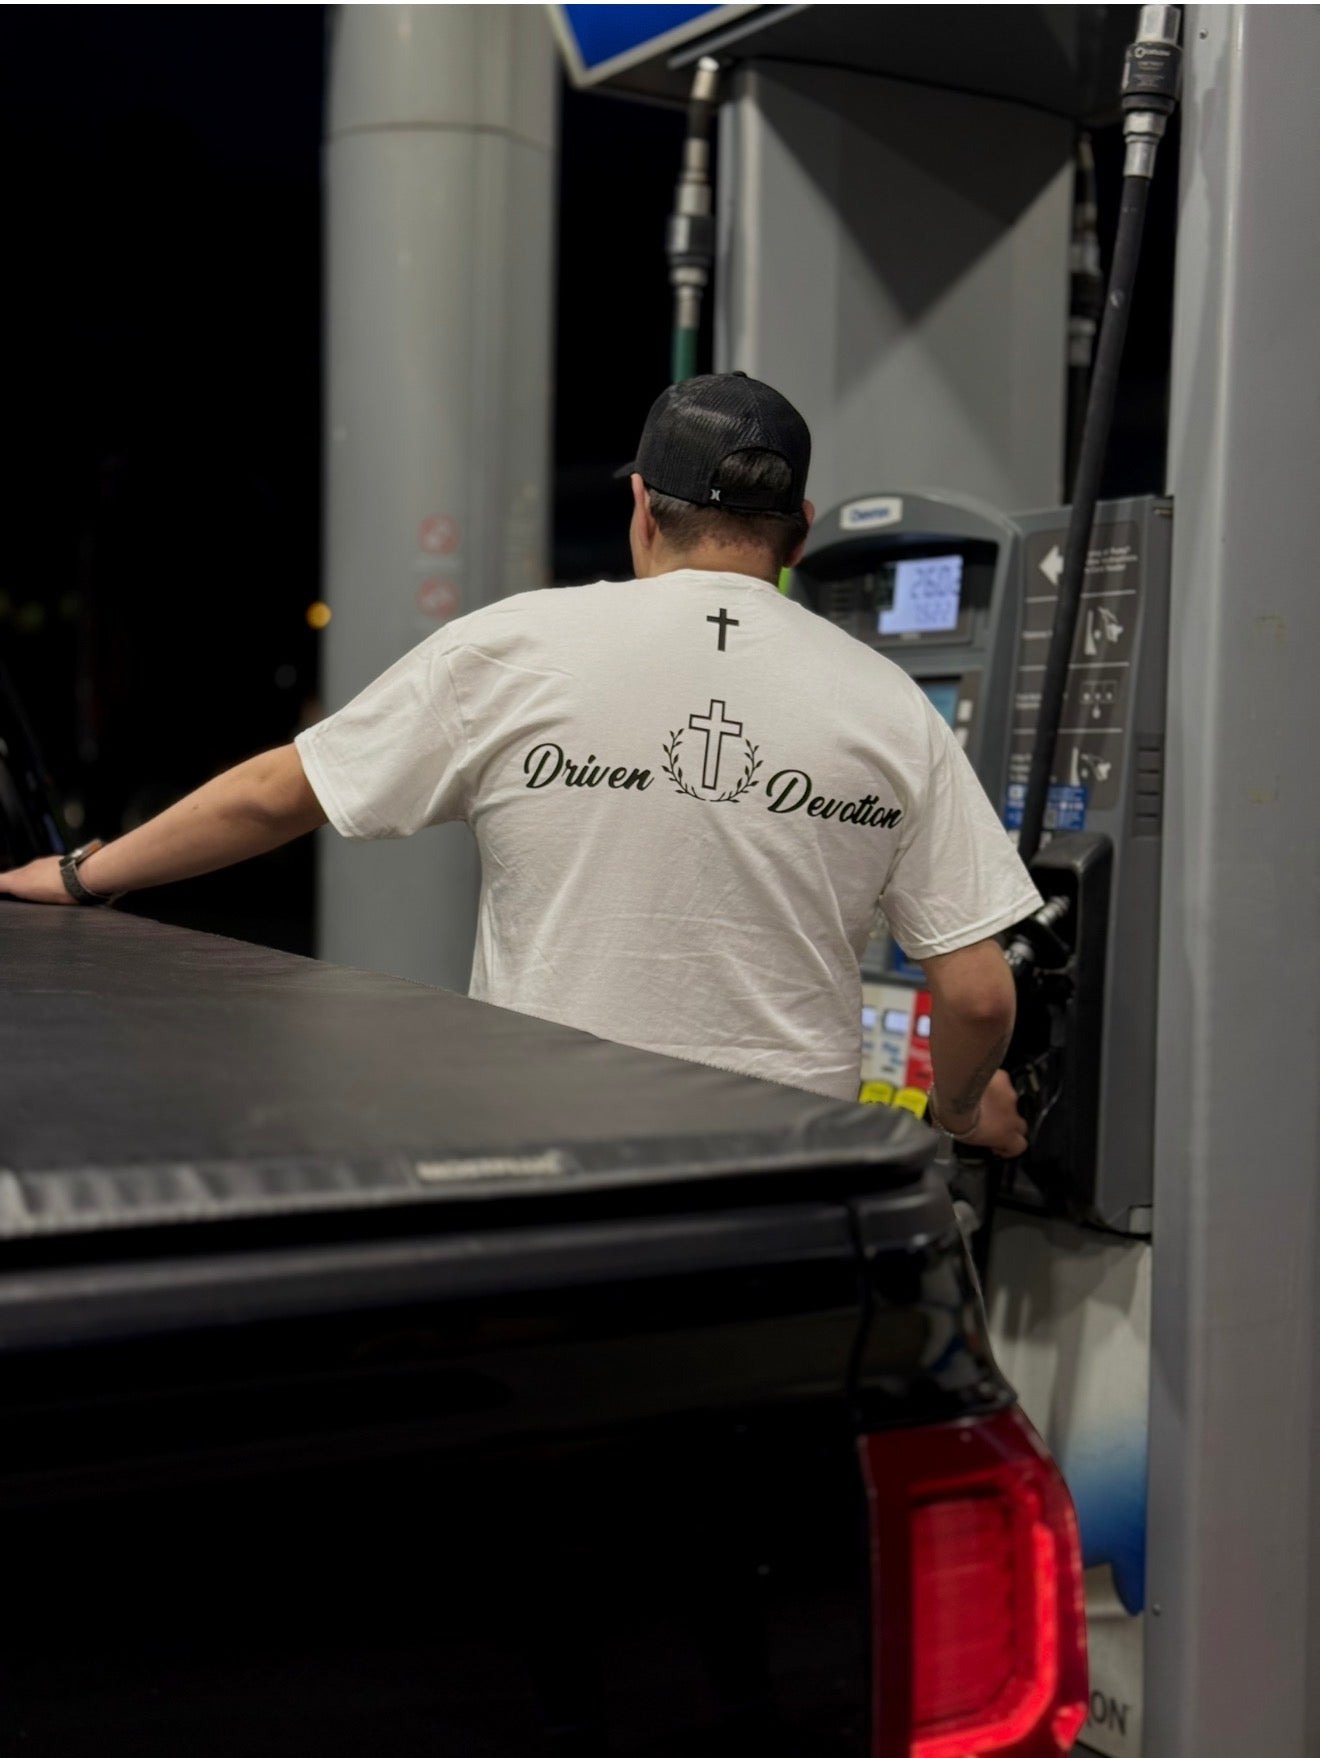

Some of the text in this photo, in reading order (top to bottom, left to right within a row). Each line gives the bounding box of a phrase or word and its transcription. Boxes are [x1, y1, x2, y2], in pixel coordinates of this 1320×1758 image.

[523, 742, 904, 829] Driven Devotion
[1087, 1690, 1129, 1736] ON
